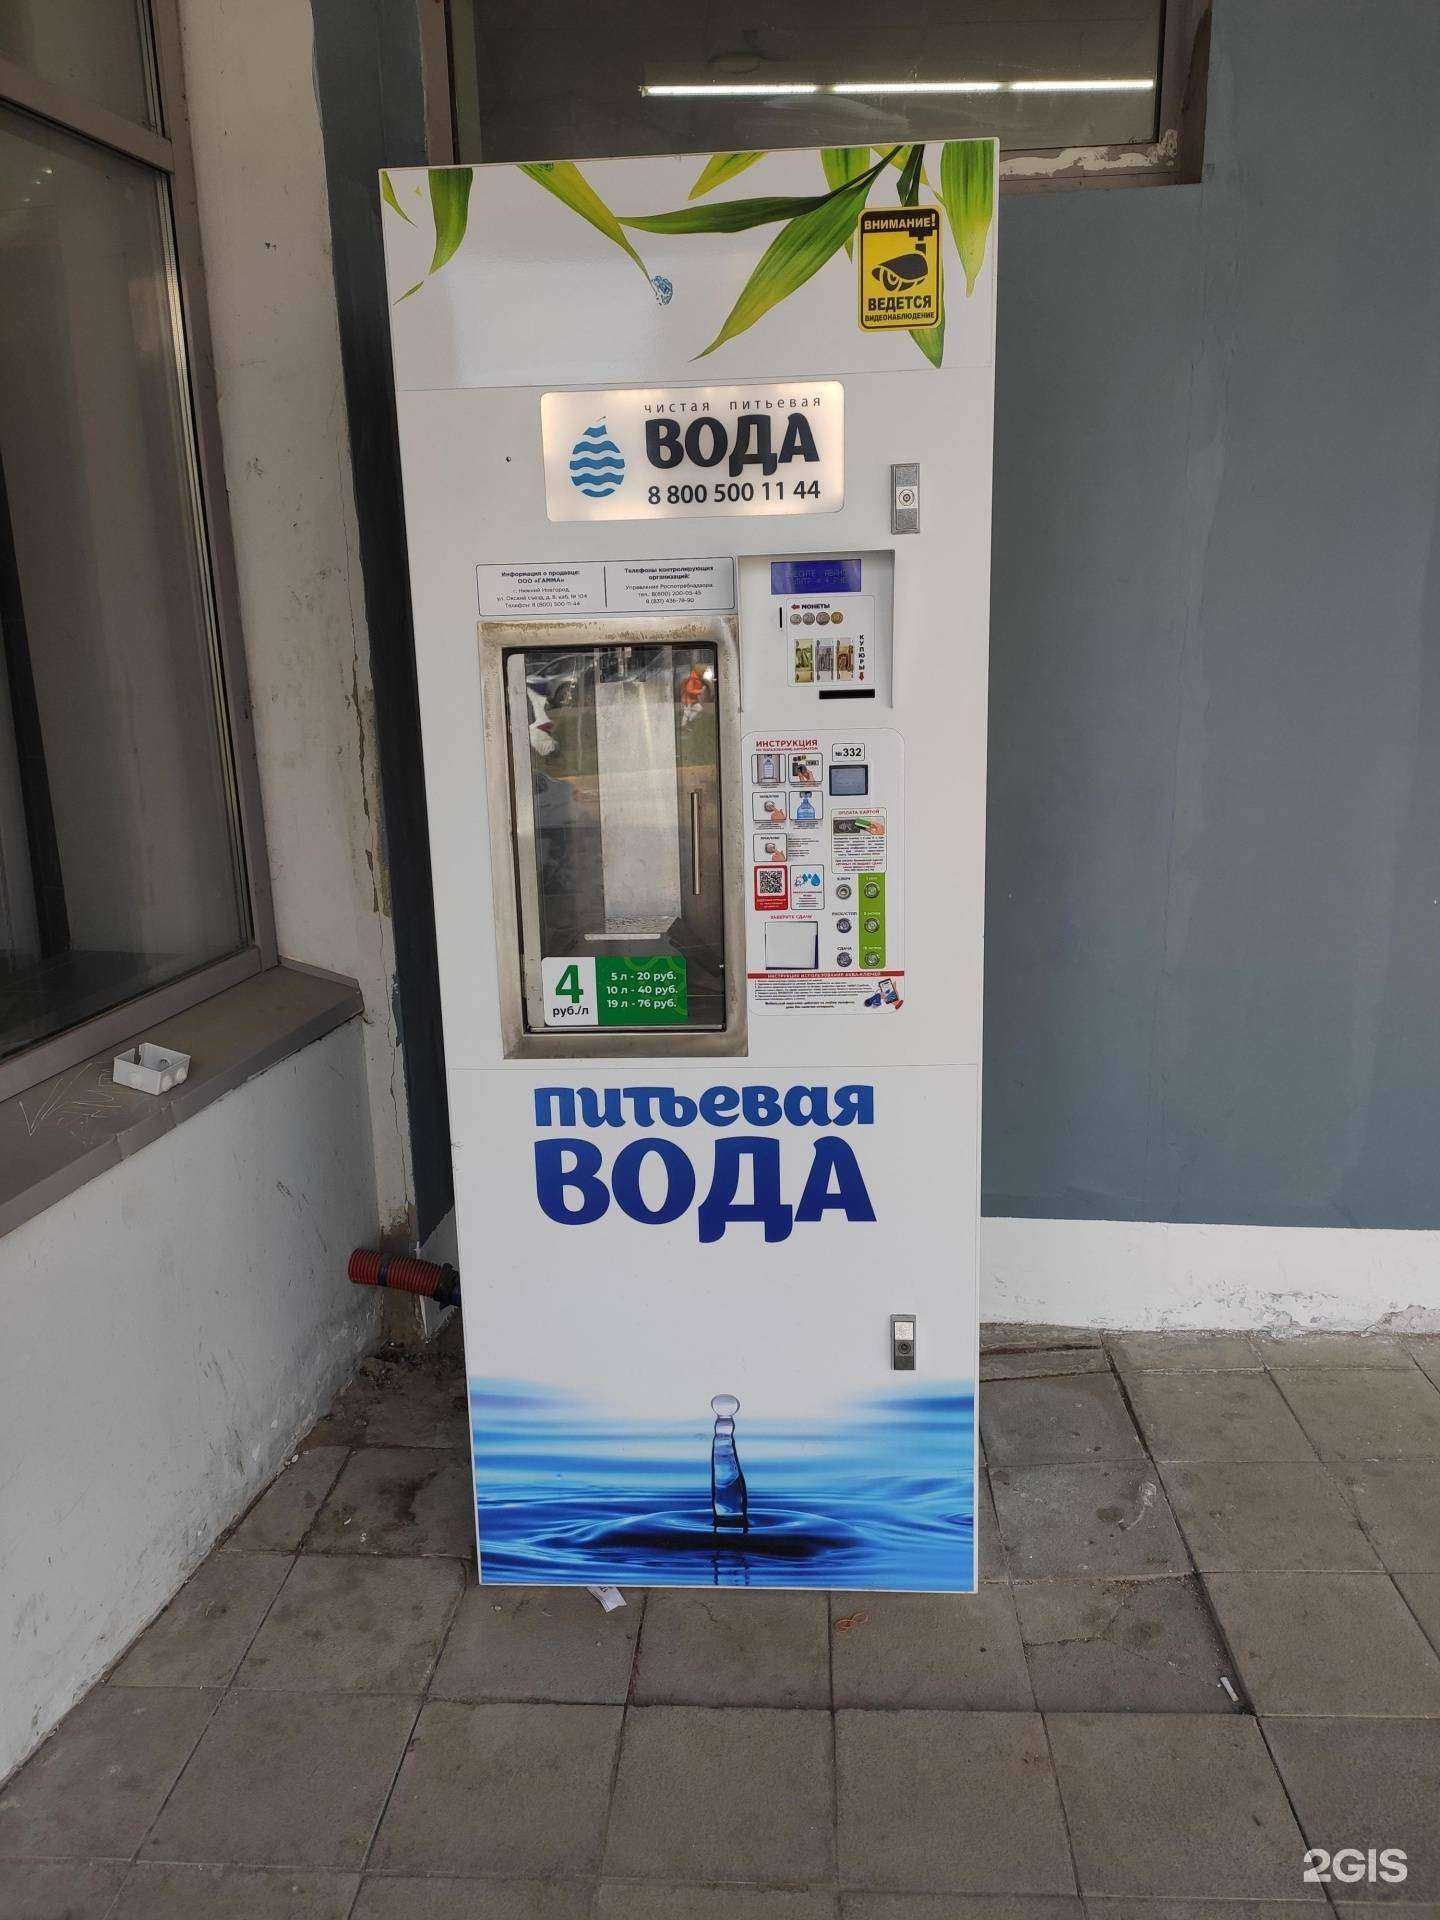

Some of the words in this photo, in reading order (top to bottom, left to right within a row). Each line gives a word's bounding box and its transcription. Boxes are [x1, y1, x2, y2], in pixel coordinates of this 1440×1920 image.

[864, 213, 936, 230] ВНИМАНИЕ!
[867, 295, 932, 312] ВЕДЕТСЯ
[864, 311, 935, 323] ВИДЕОНАБЛЮДЕНИЕ
[644, 402, 710, 413] чистая
[730, 397, 821, 411] питьевая
[645, 412, 820, 477] ВОДА
[648, 485, 661, 505] 8
[667, 484, 708, 504] 800
[714, 482, 754, 503] 500
[762, 481, 784, 500] 11
[792, 480, 821, 499] 44
[659, 565, 713, 573] контролирующих
[756, 739, 818, 749] ИНСТРУКЦИЯ
[555, 964, 584, 1004] 4
[611, 972, 618, 980] 5
[637, 971, 651, 980] 20
[653, 971, 677, 982] руб.
[606, 986, 617, 995] 10
[637, 985, 652, 994] 40
[655, 985, 678, 996] руб.
[552, 1006, 589, 1017] руб./л
[607, 999, 618, 1008] 19
[638, 999, 651, 1008] 76
[653, 998, 677, 1009] руб.
[533, 1084, 875, 1128] питьевая
[533, 1135, 877, 1244] ВОДА
